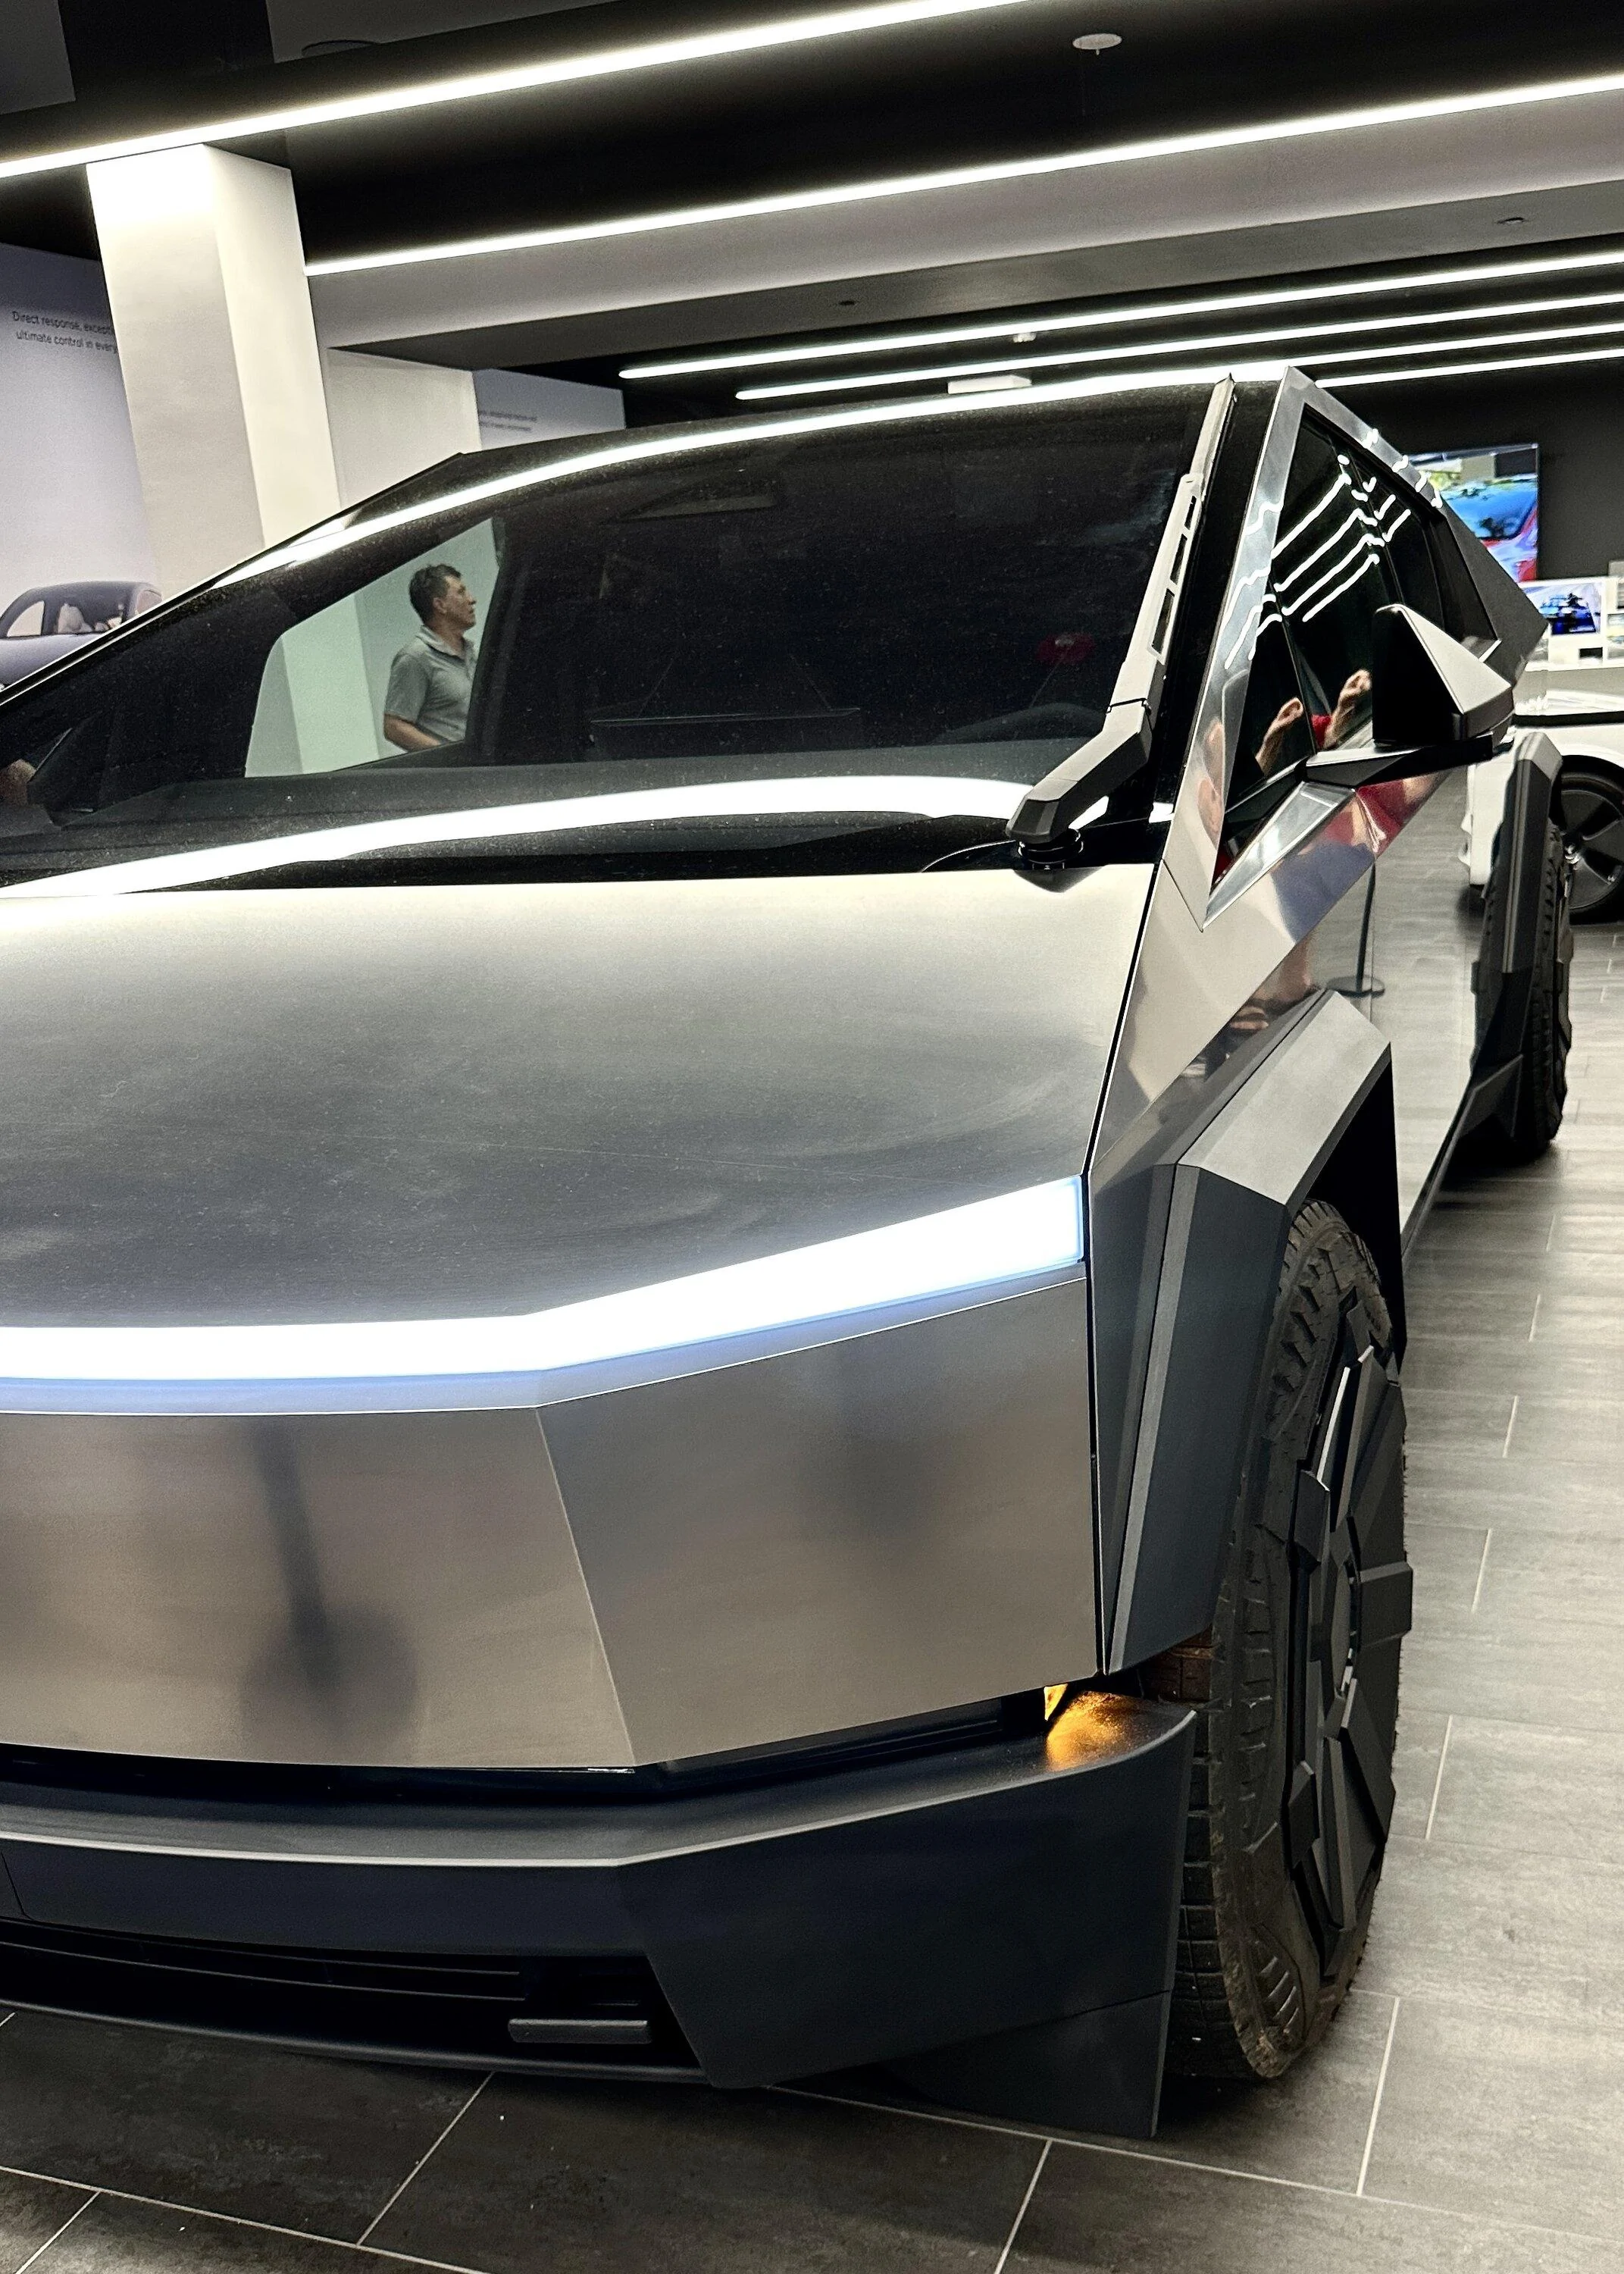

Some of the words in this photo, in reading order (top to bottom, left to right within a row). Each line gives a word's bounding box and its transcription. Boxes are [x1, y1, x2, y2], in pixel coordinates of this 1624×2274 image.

[12, 311, 39, 324] Direct
[16, 330, 52, 343] ultimate
[54, 336, 83, 348] control
